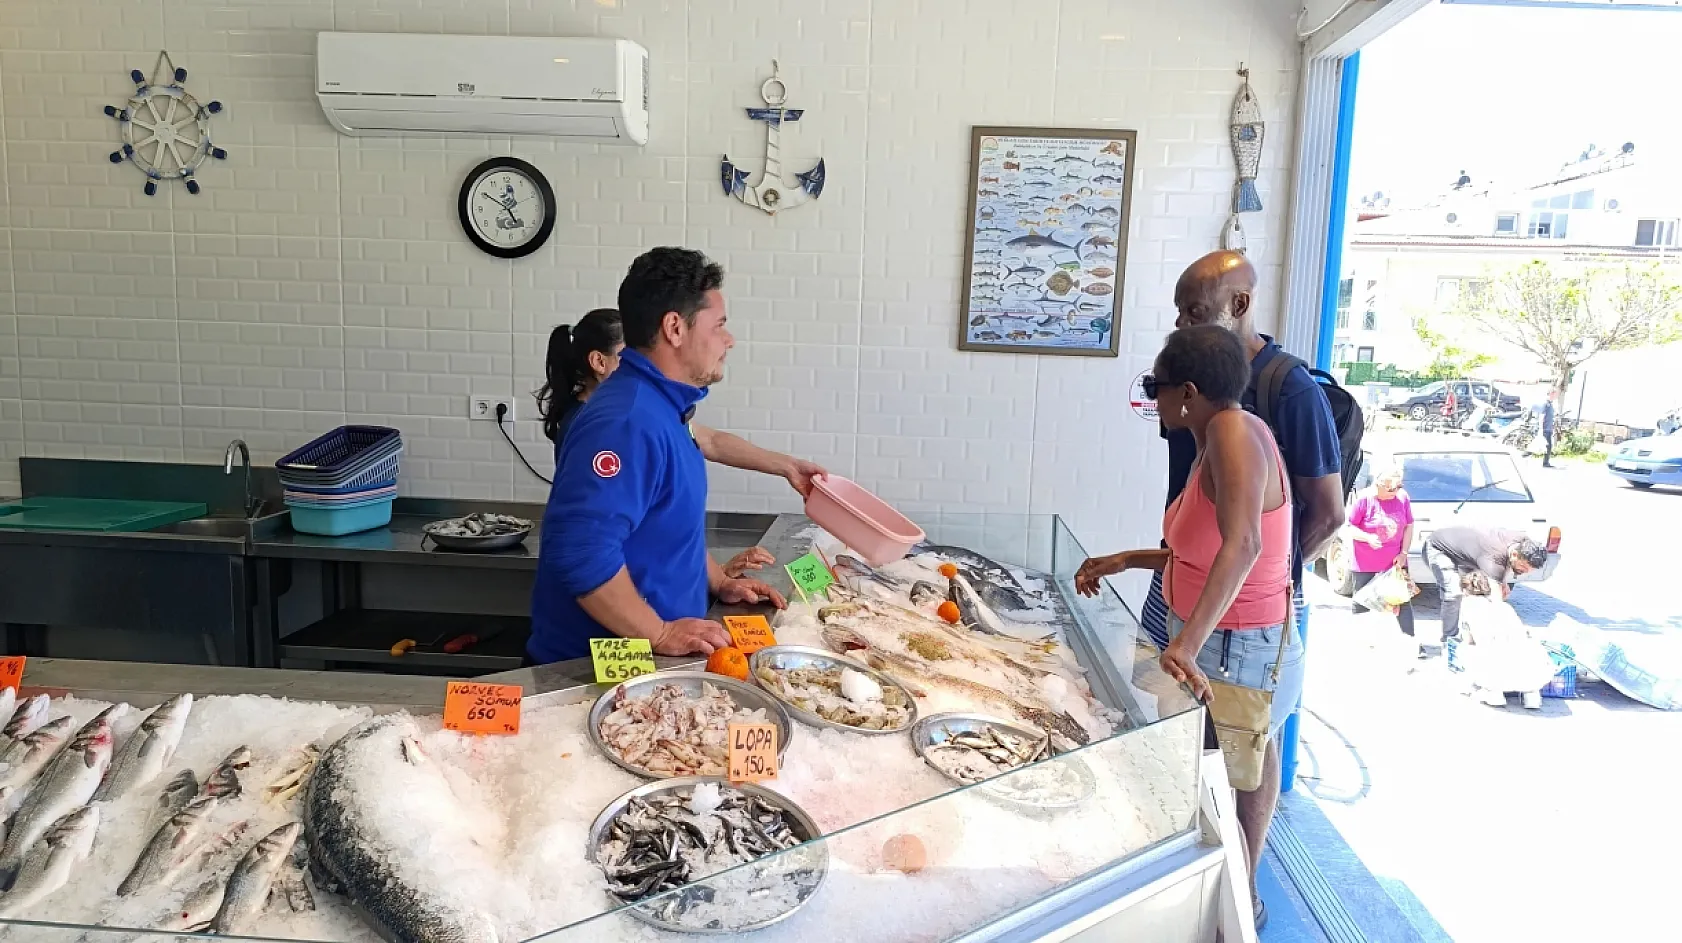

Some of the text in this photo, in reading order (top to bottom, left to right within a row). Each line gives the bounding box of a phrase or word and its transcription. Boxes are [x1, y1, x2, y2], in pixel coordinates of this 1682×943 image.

[490, 180, 497, 188] 11
[502, 176, 511, 184] 12
[483, 219, 489, 228] 8
[508, 232, 514, 240] 6
[592, 640, 630, 650] TAZE
[605, 664, 641, 679] 650
[467, 706, 496, 720] 650
[735, 728, 772, 751] LOPA
[744, 755, 764, 776] 150
